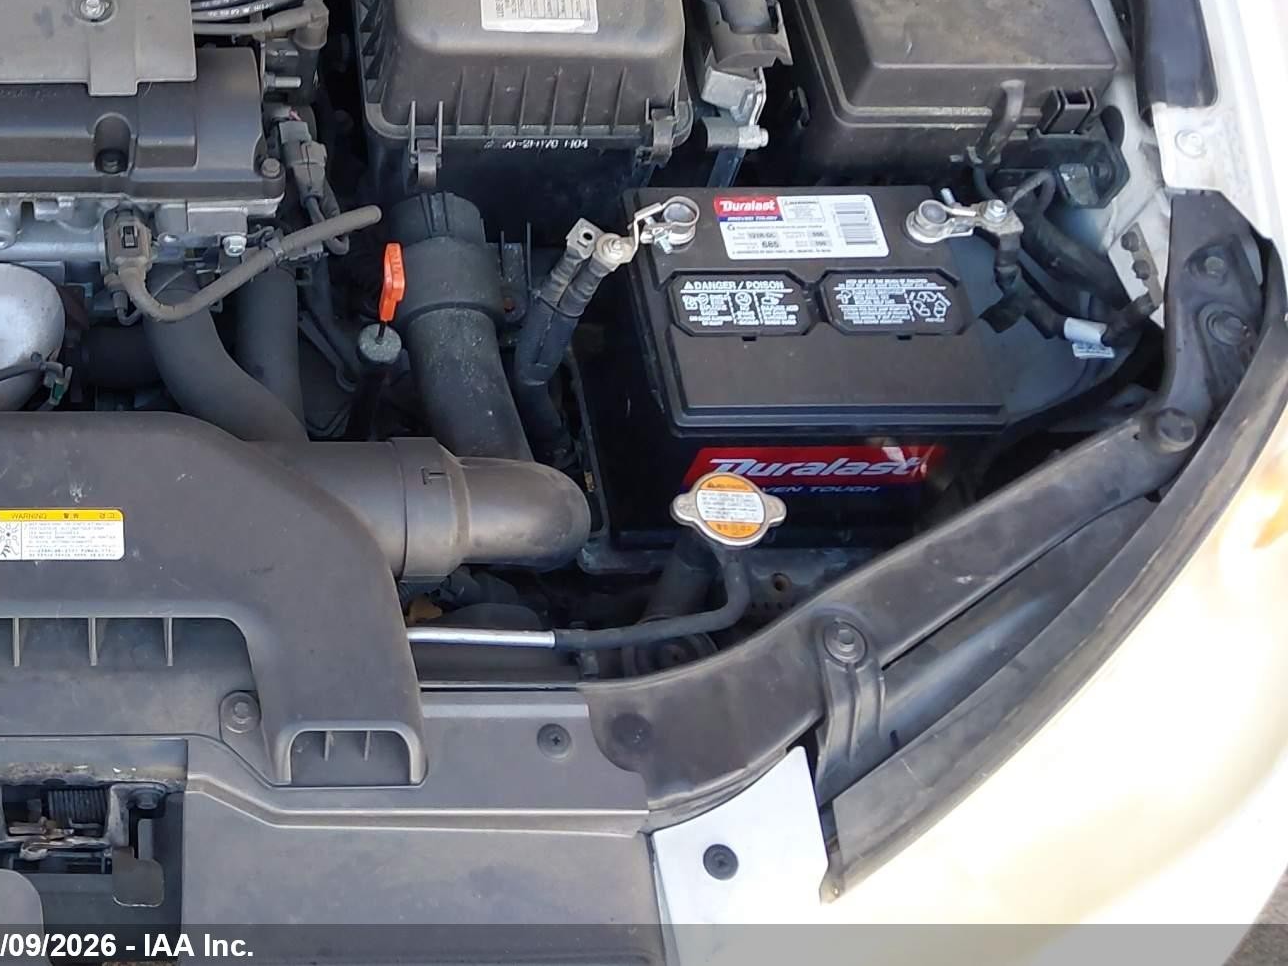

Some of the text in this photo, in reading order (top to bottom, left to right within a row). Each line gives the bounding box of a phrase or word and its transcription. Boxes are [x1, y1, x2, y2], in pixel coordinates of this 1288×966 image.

[719, 200, 776, 212] Duralast
[693, 281, 737, 290] DANGER
[746, 280, 784, 290] POISON
[808, 485, 880, 493] TOUGH
[10, 512, 48, 520] WARNING
